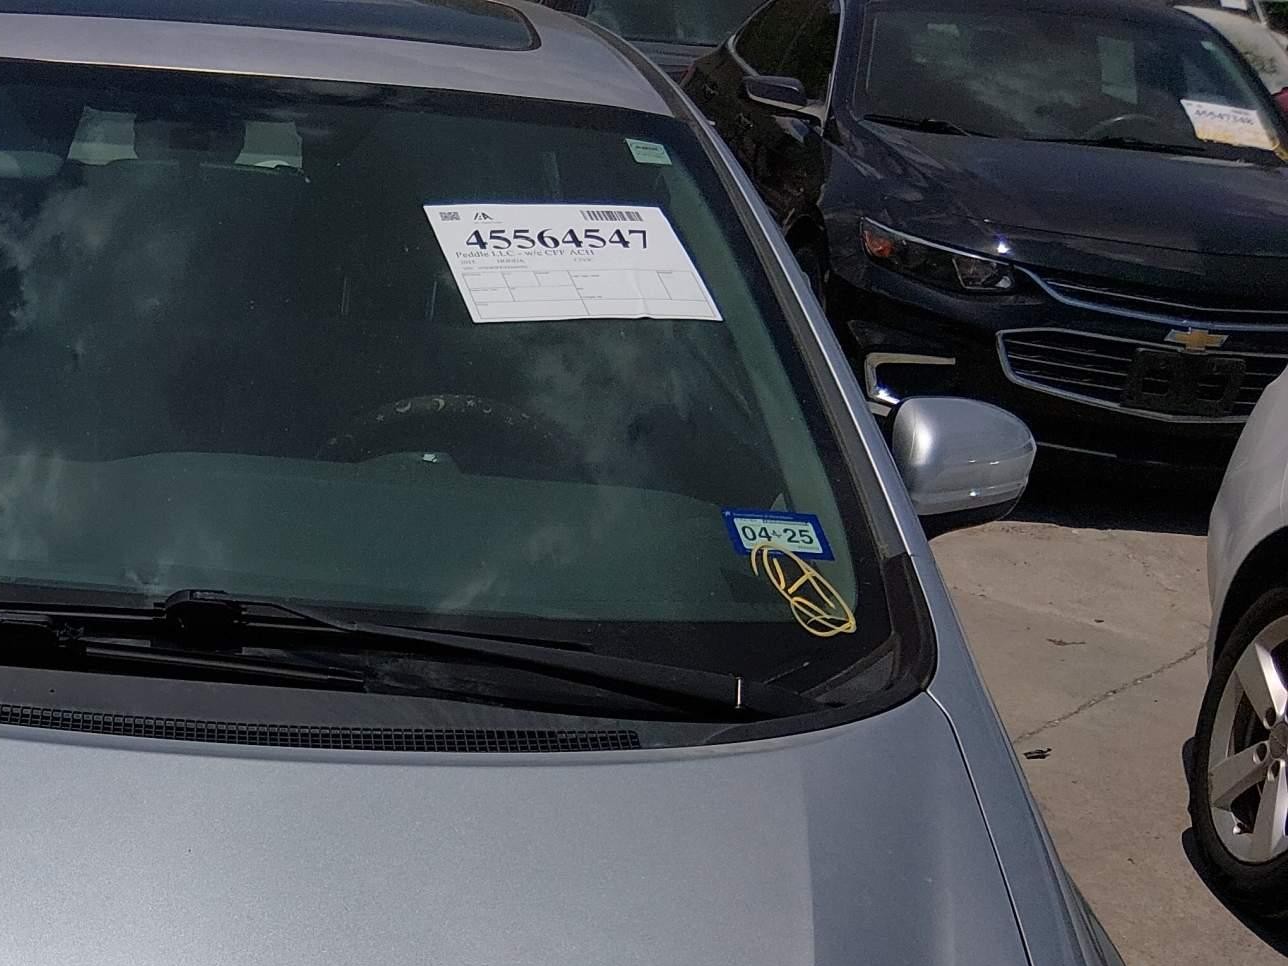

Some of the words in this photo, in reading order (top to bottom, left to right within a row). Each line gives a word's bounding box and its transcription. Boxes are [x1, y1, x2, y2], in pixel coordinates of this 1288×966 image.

[465, 229, 648, 250] 45564547
[741, 525, 772, 542] 04
[782, 528, 814, 545] 25
